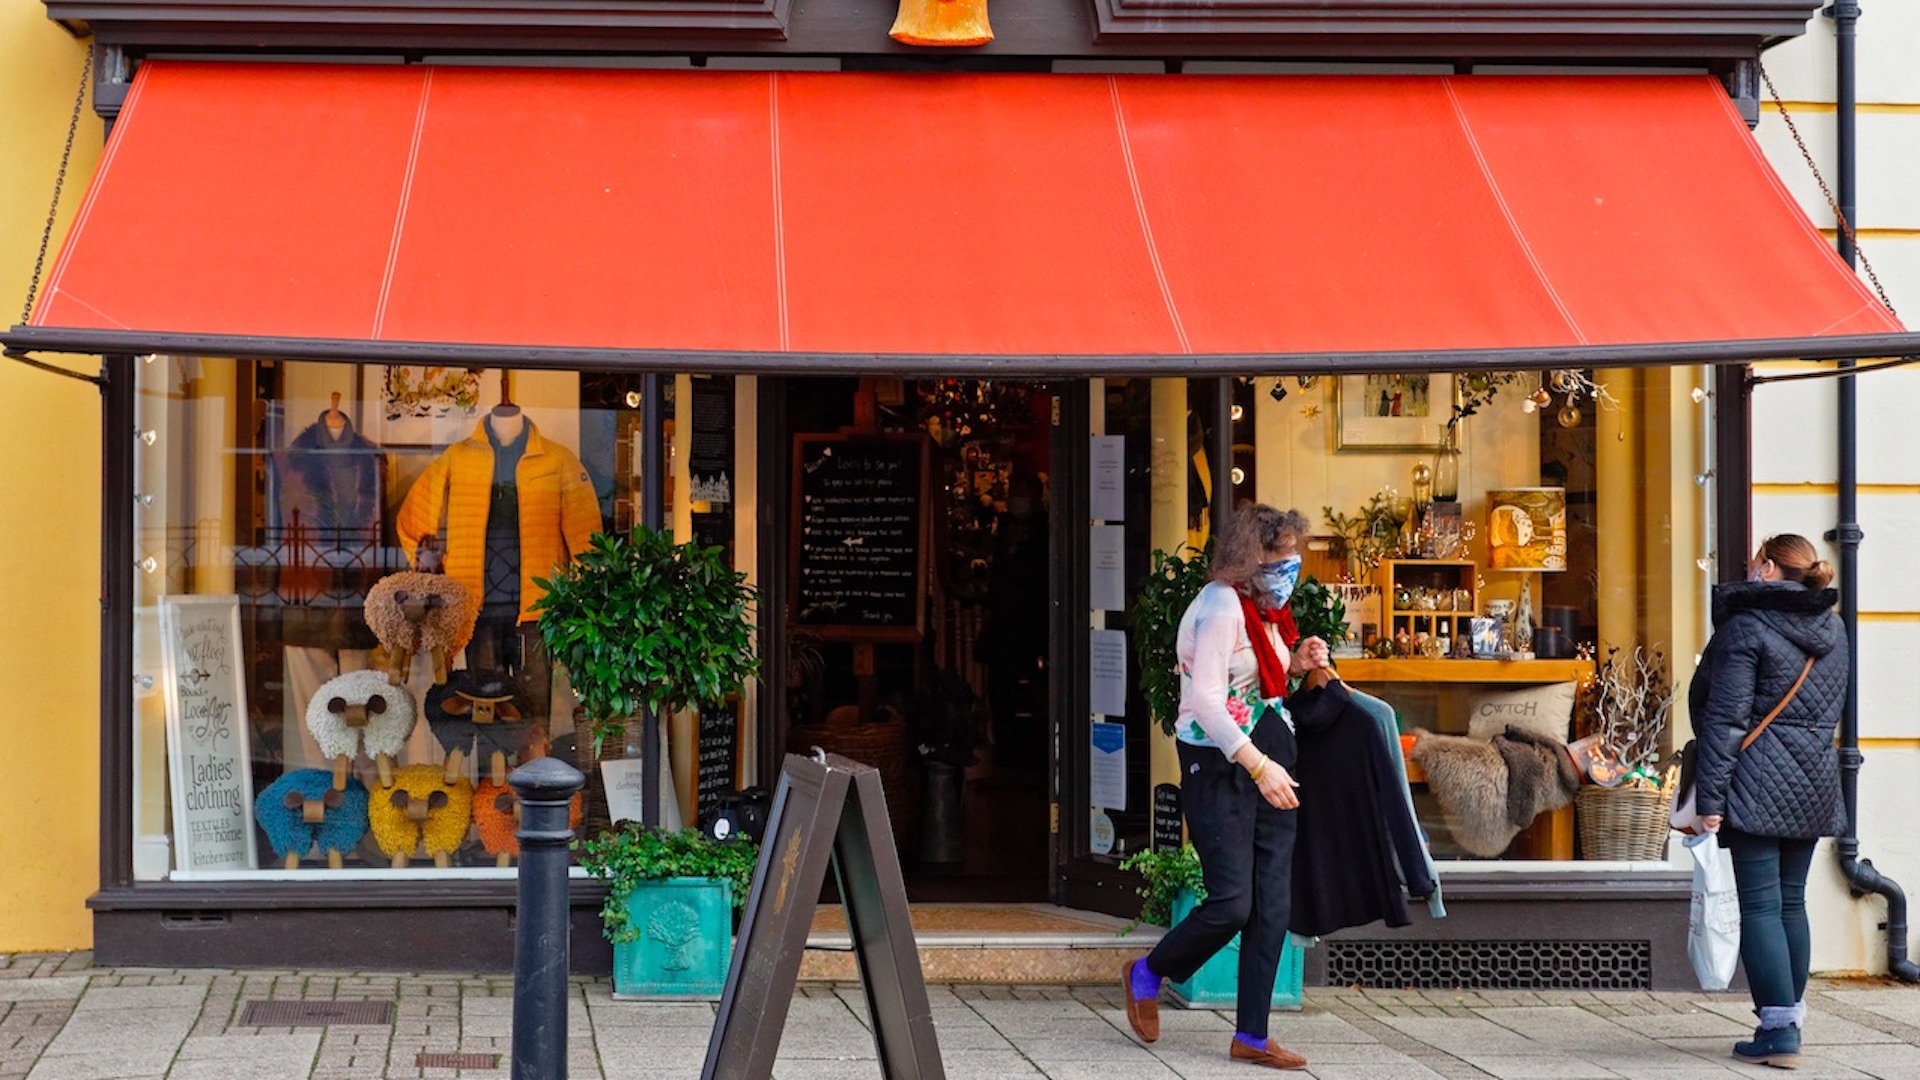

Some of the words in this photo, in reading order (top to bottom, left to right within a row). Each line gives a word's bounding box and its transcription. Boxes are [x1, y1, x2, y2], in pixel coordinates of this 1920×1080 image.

[190, 754, 234, 786] Ladies'
[186, 783, 242, 817] clothing
[189, 818, 231, 832] TEXTILES
[214, 827, 242, 843] home
[192, 850, 245, 866] kitchenware
